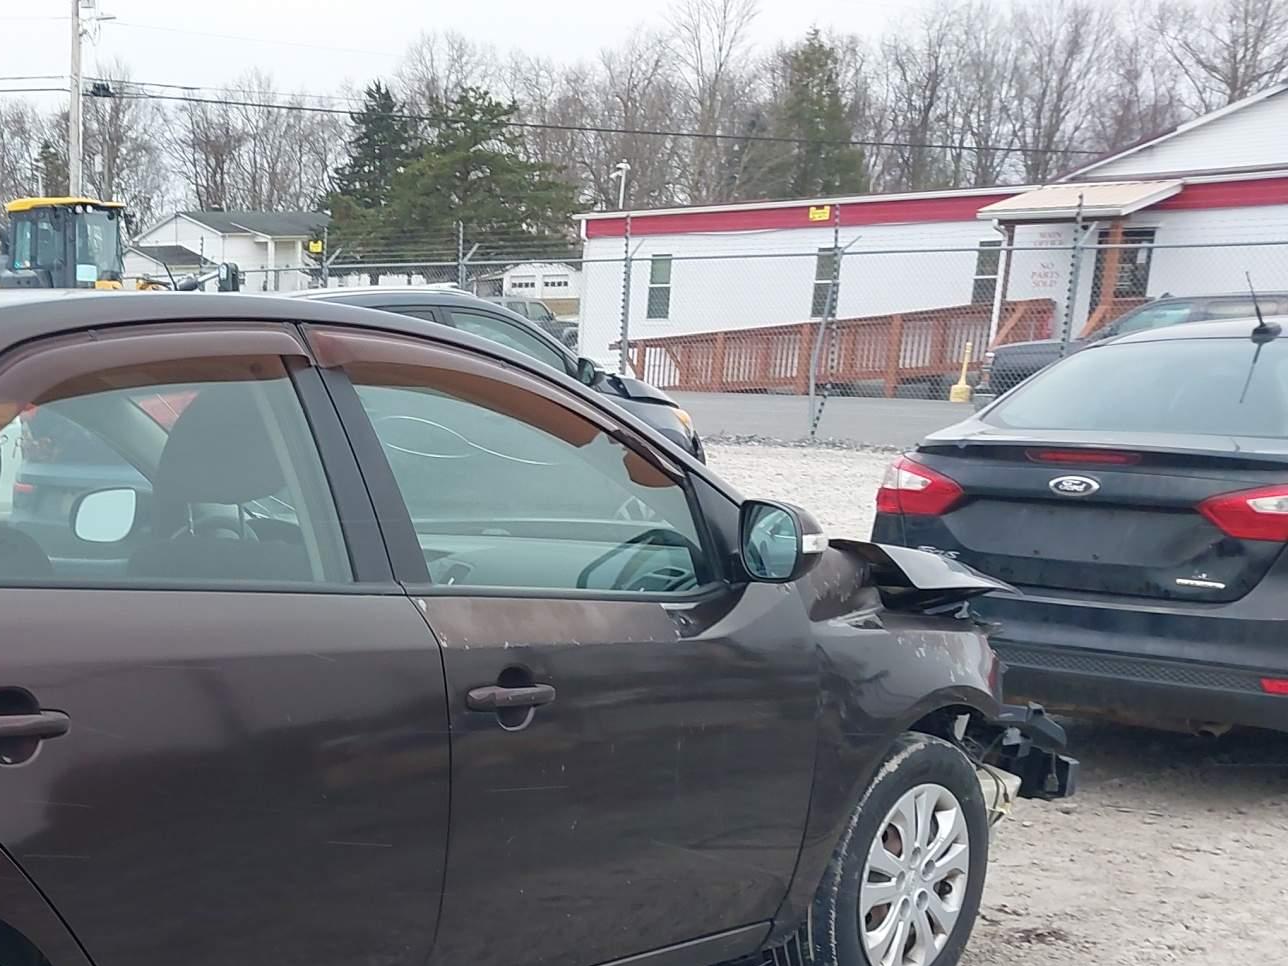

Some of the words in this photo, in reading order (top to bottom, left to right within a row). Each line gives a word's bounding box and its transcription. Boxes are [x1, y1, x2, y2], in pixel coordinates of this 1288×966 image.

[1040, 261, 1055, 270] NO
[1031, 271, 1060, 280] PARTS
[1031, 280, 1058, 289] SOLD
